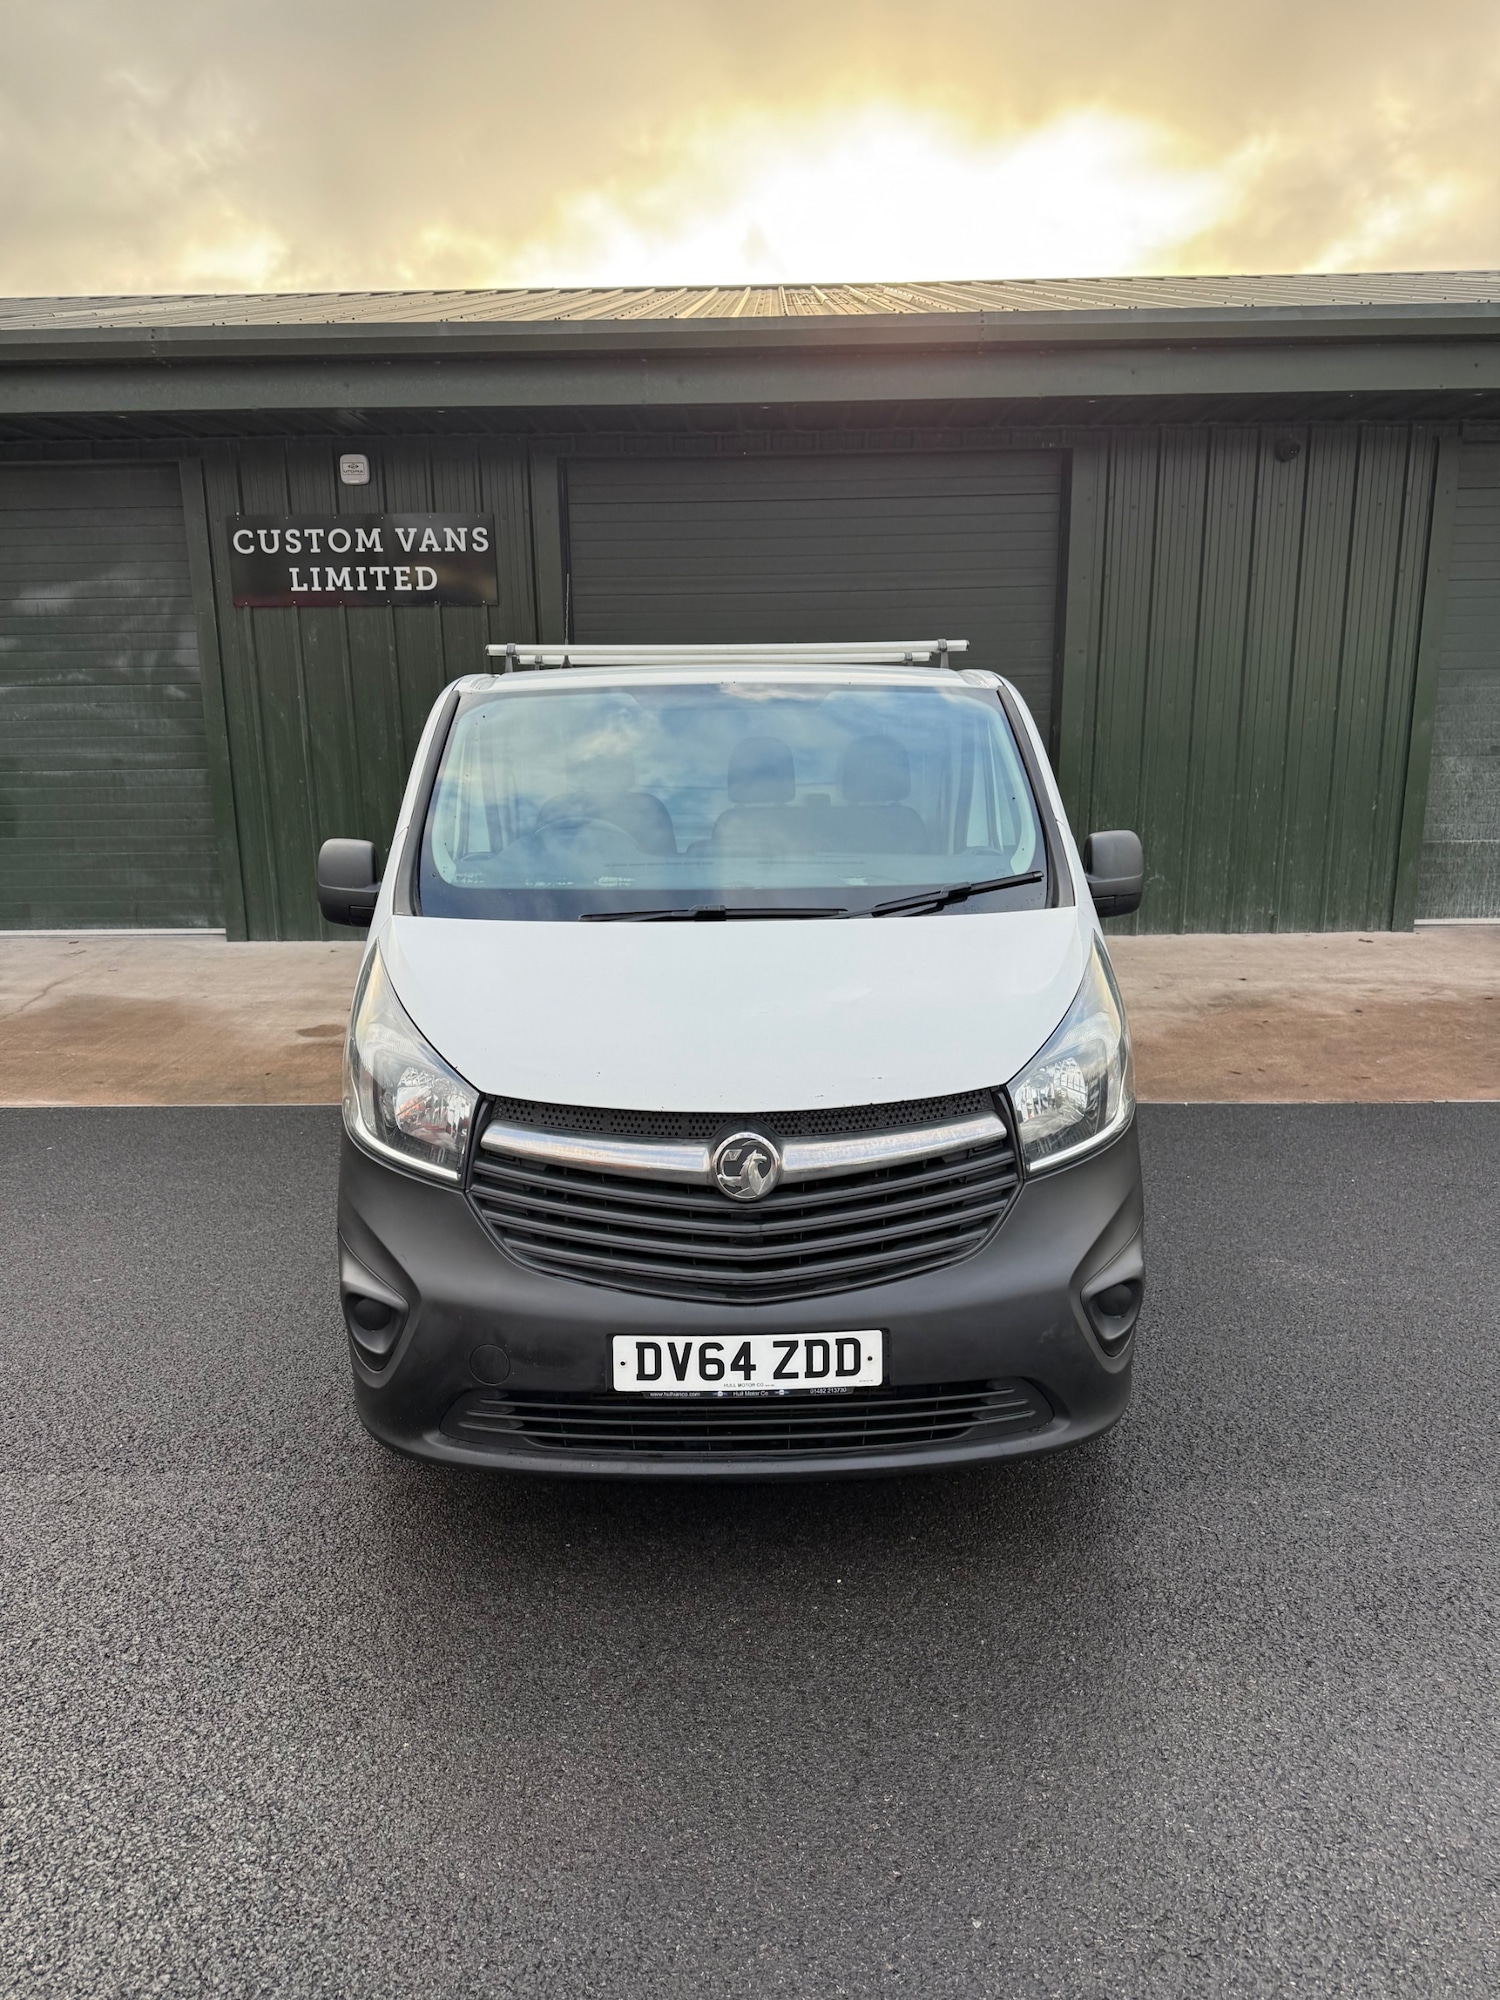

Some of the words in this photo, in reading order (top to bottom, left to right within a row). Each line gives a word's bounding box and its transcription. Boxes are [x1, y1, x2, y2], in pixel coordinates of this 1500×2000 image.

[233, 528, 384, 554] CUSTOM
[395, 527, 489, 552] VANS
[289, 566, 438, 591] LIMITED
[635, 1341, 756, 1381] DV64
[772, 1338, 861, 1379] ZDD
